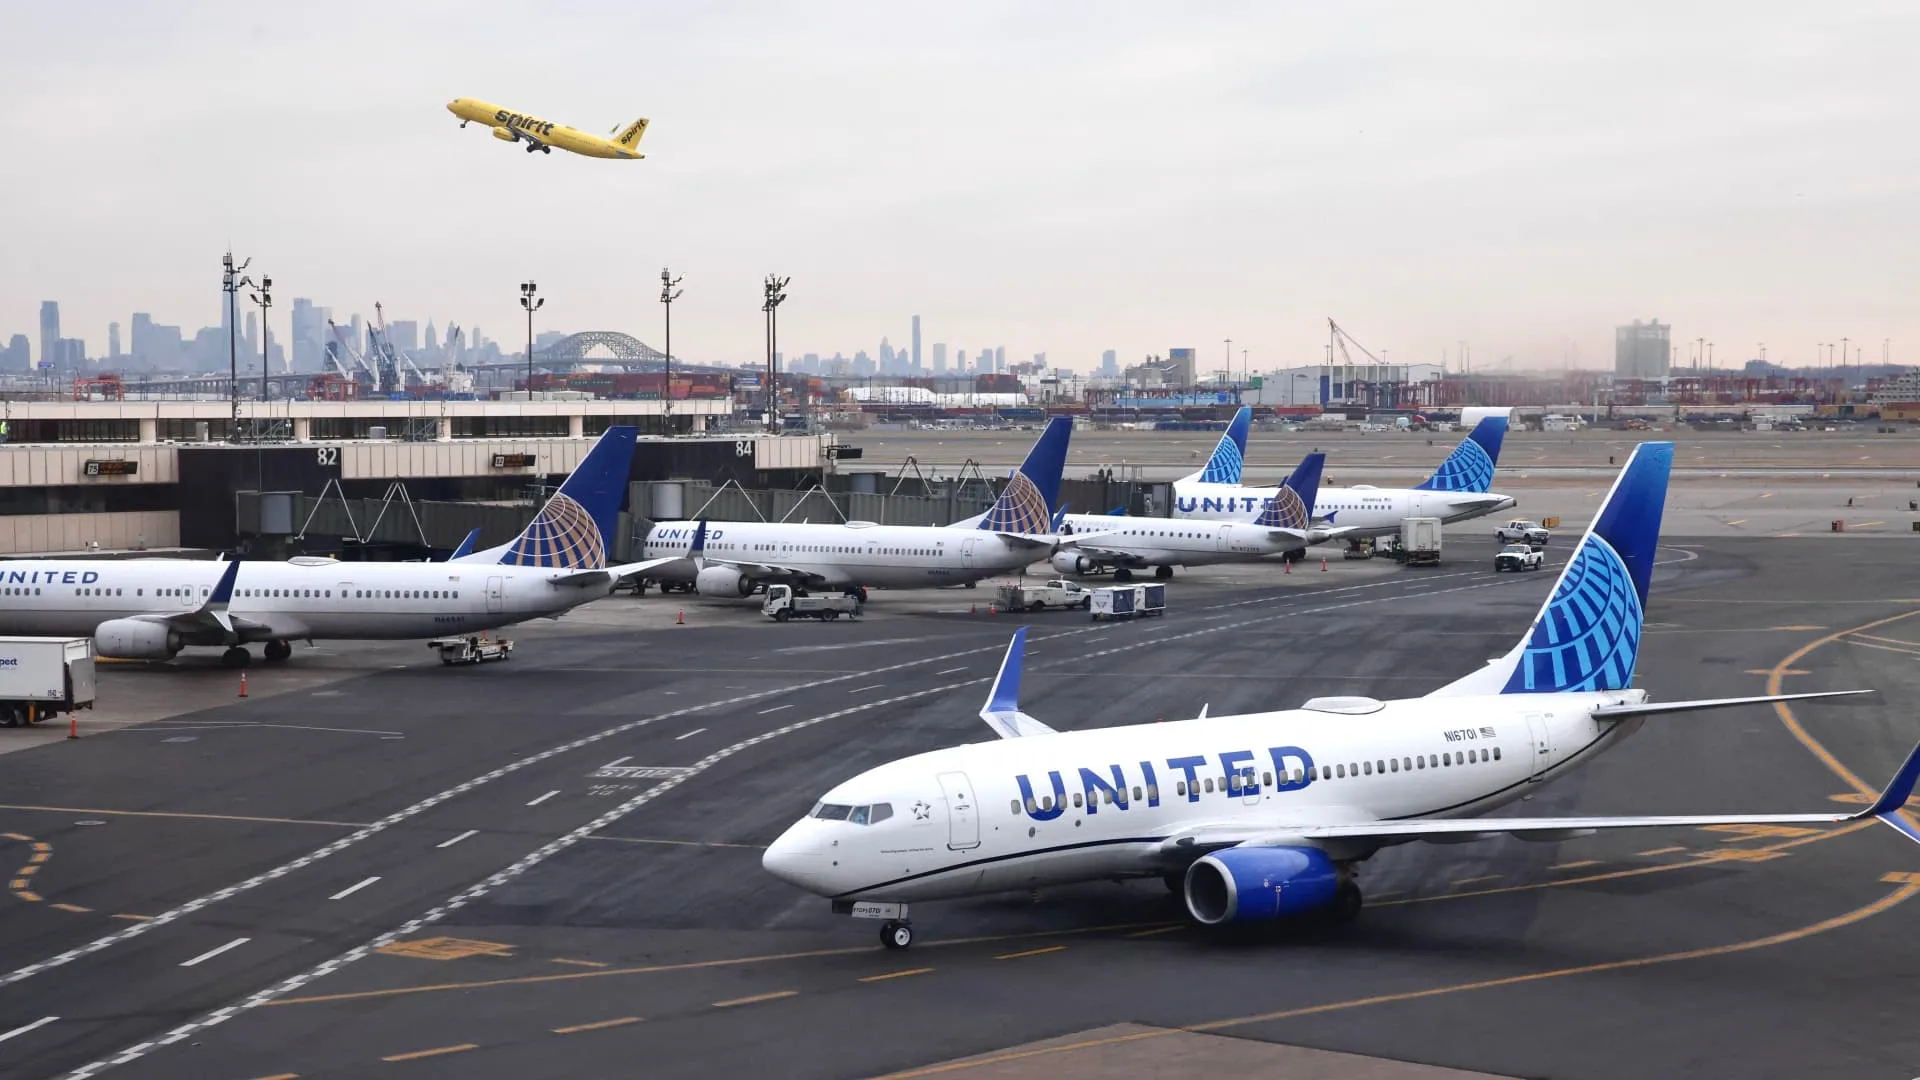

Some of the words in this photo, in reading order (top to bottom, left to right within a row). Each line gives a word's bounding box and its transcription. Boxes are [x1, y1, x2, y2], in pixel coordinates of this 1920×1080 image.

[495, 110, 554, 136] spirit
[620, 119, 645, 145] spirit
[317, 447, 337, 465] 82
[736, 440, 752, 456] 84
[0, 571, 99, 584] NITED
[1444, 728, 1478, 742] N16701
[596, 769, 672, 778] STOP
[1016, 746, 1316, 821] UNITED
